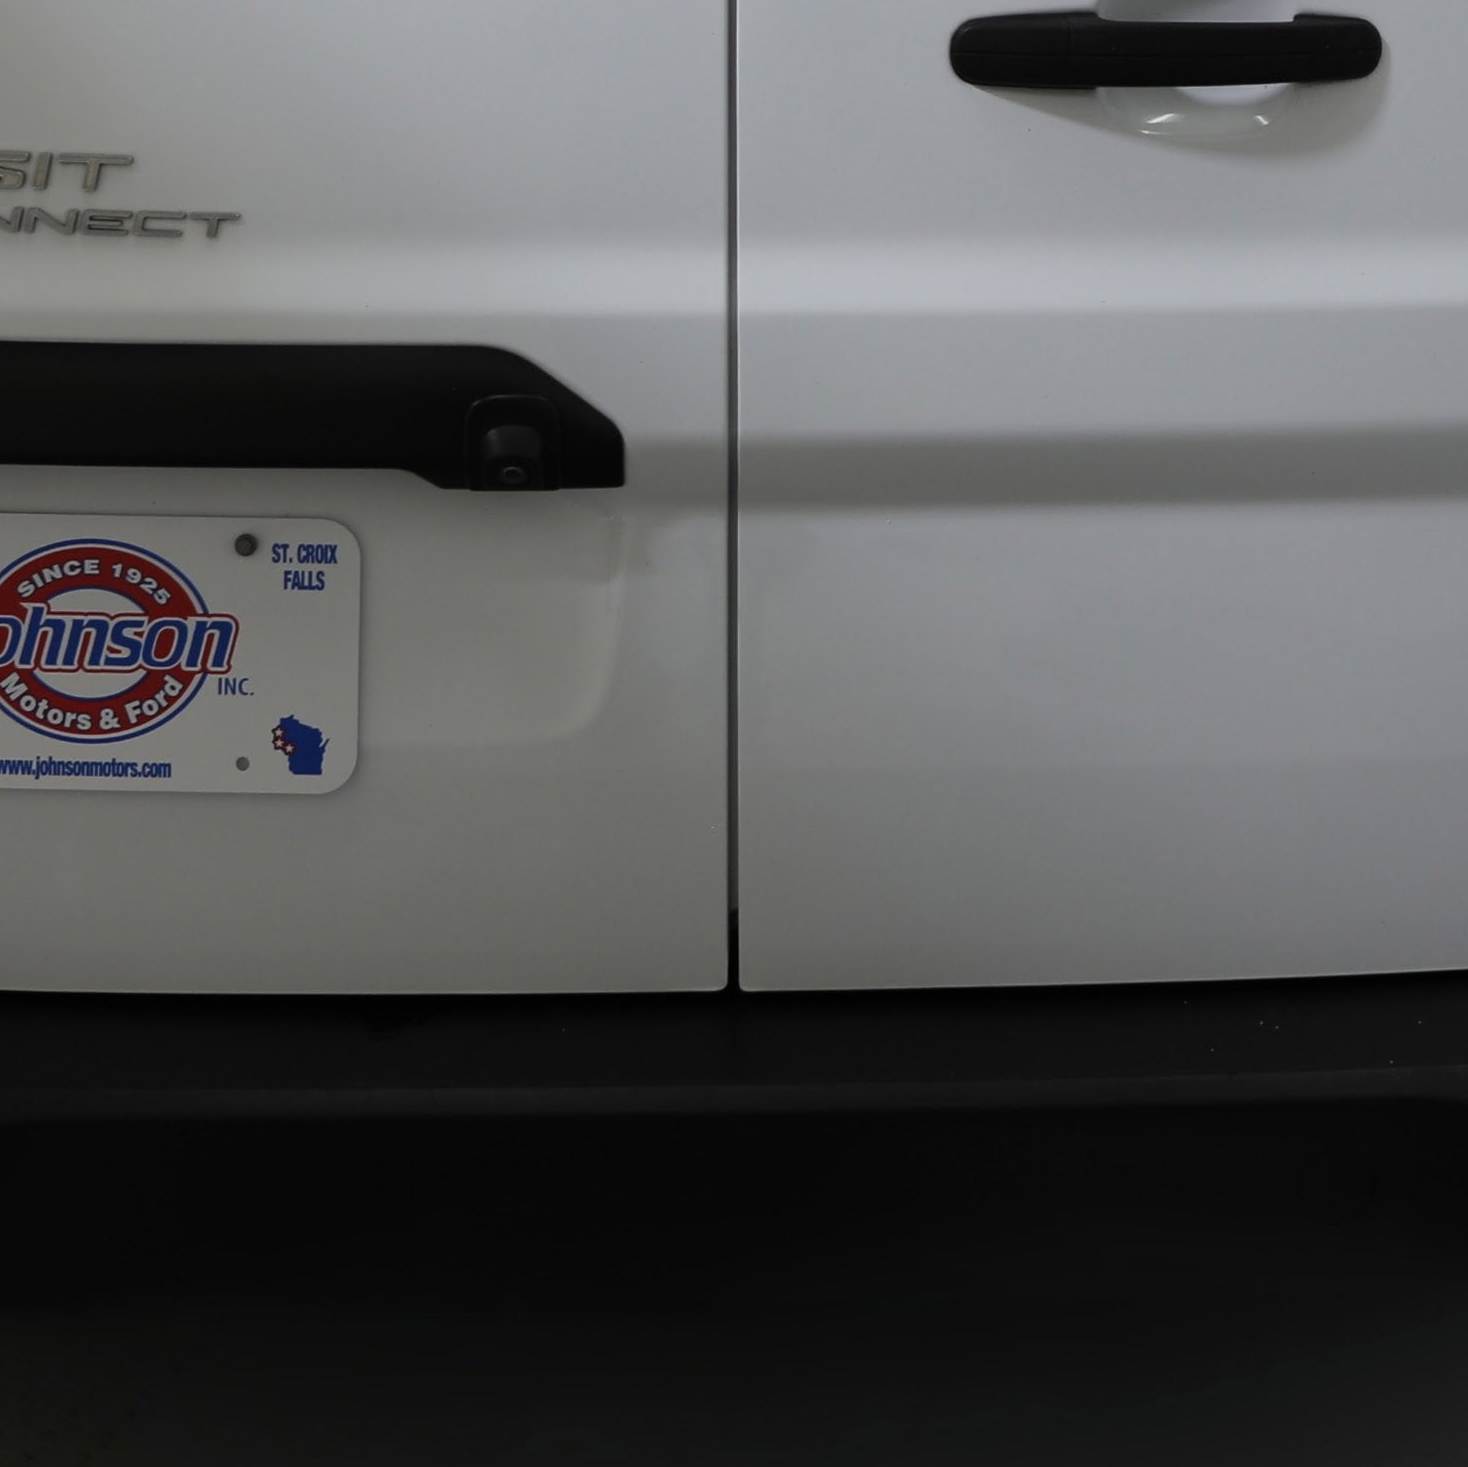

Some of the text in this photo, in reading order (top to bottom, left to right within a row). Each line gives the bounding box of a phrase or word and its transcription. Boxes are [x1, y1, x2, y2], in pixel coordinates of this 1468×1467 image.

[271, 543, 338, 565] ST. CROIX
[17, 559, 172, 606] SINCE 1925
[283, 570, 325, 591] FALLS
[218, 676, 255, 696] INC.
[0, 672, 183, 731] Motors & Ford
